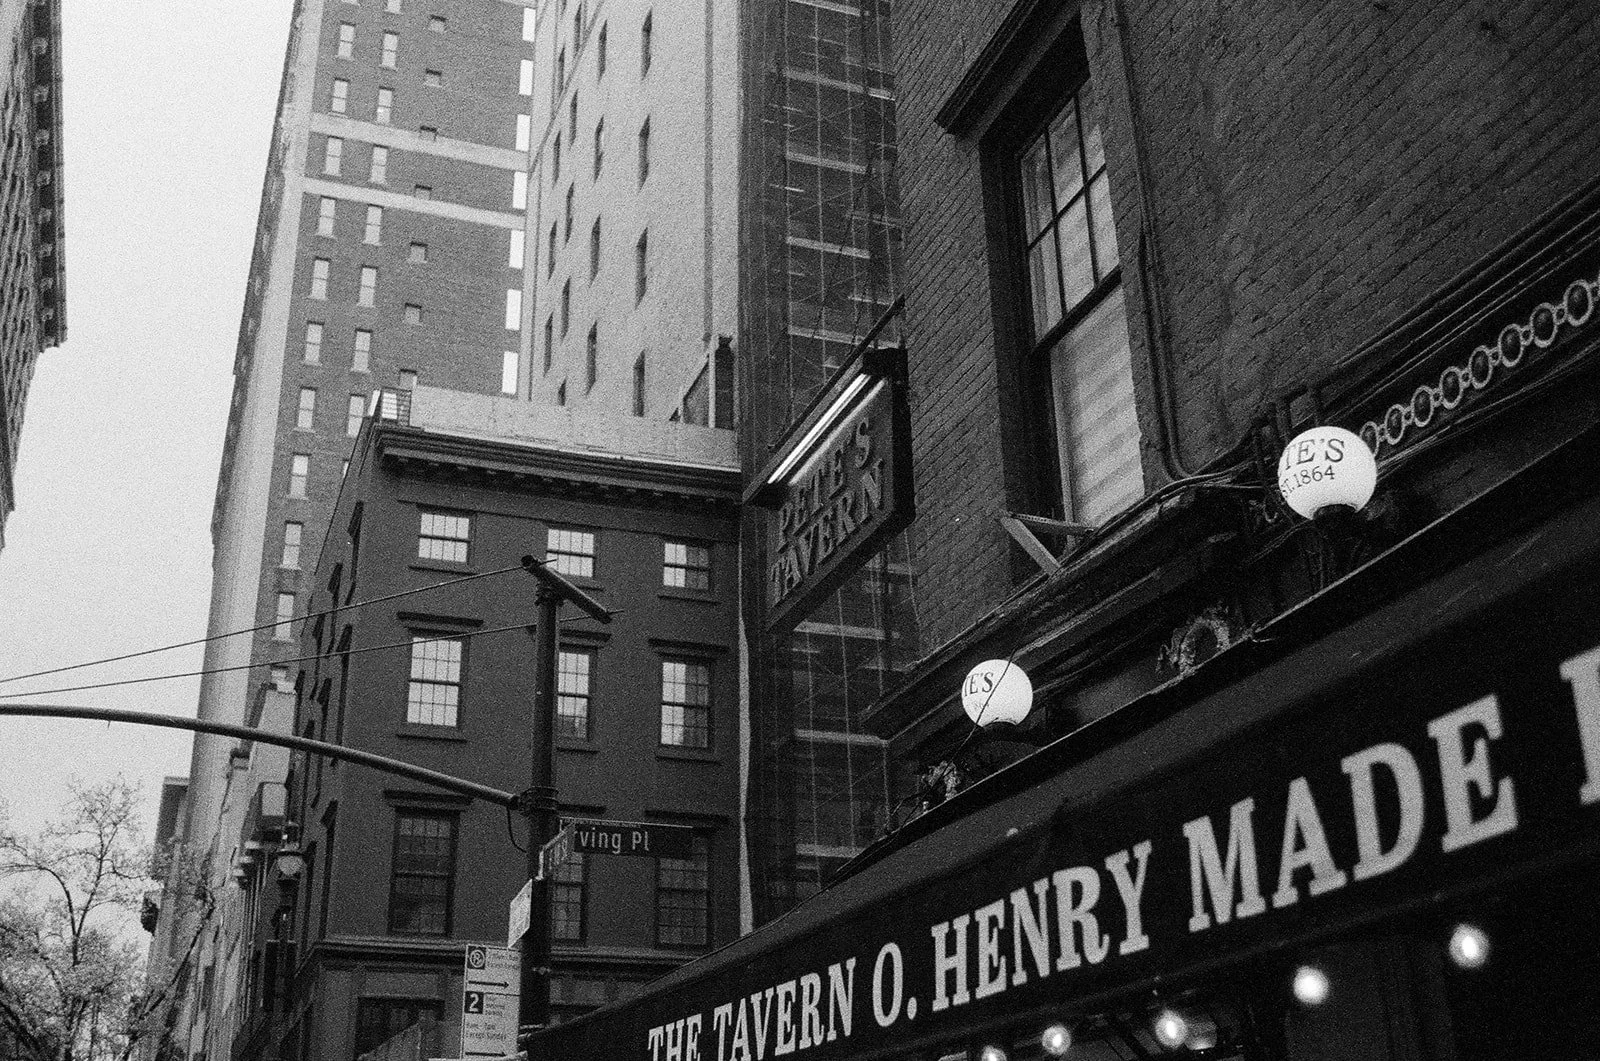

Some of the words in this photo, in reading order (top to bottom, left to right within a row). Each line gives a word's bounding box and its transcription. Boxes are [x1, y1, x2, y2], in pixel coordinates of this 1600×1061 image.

[767, 456, 885, 604] TAVERN
[776, 416, 871, 552] PETE'S
[575, 826, 621, 853] ving
[631, 832, 650, 851] Pl
[648, 1014, 702, 1061] THE
[713, 957, 857, 1061] TAVERN
[872, 942, 918, 1027] O.
[931, 839, 1152, 1011] HENRY
[1182, 694, 1518, 933] MADE
[469, 993, 479, 1012] 2
